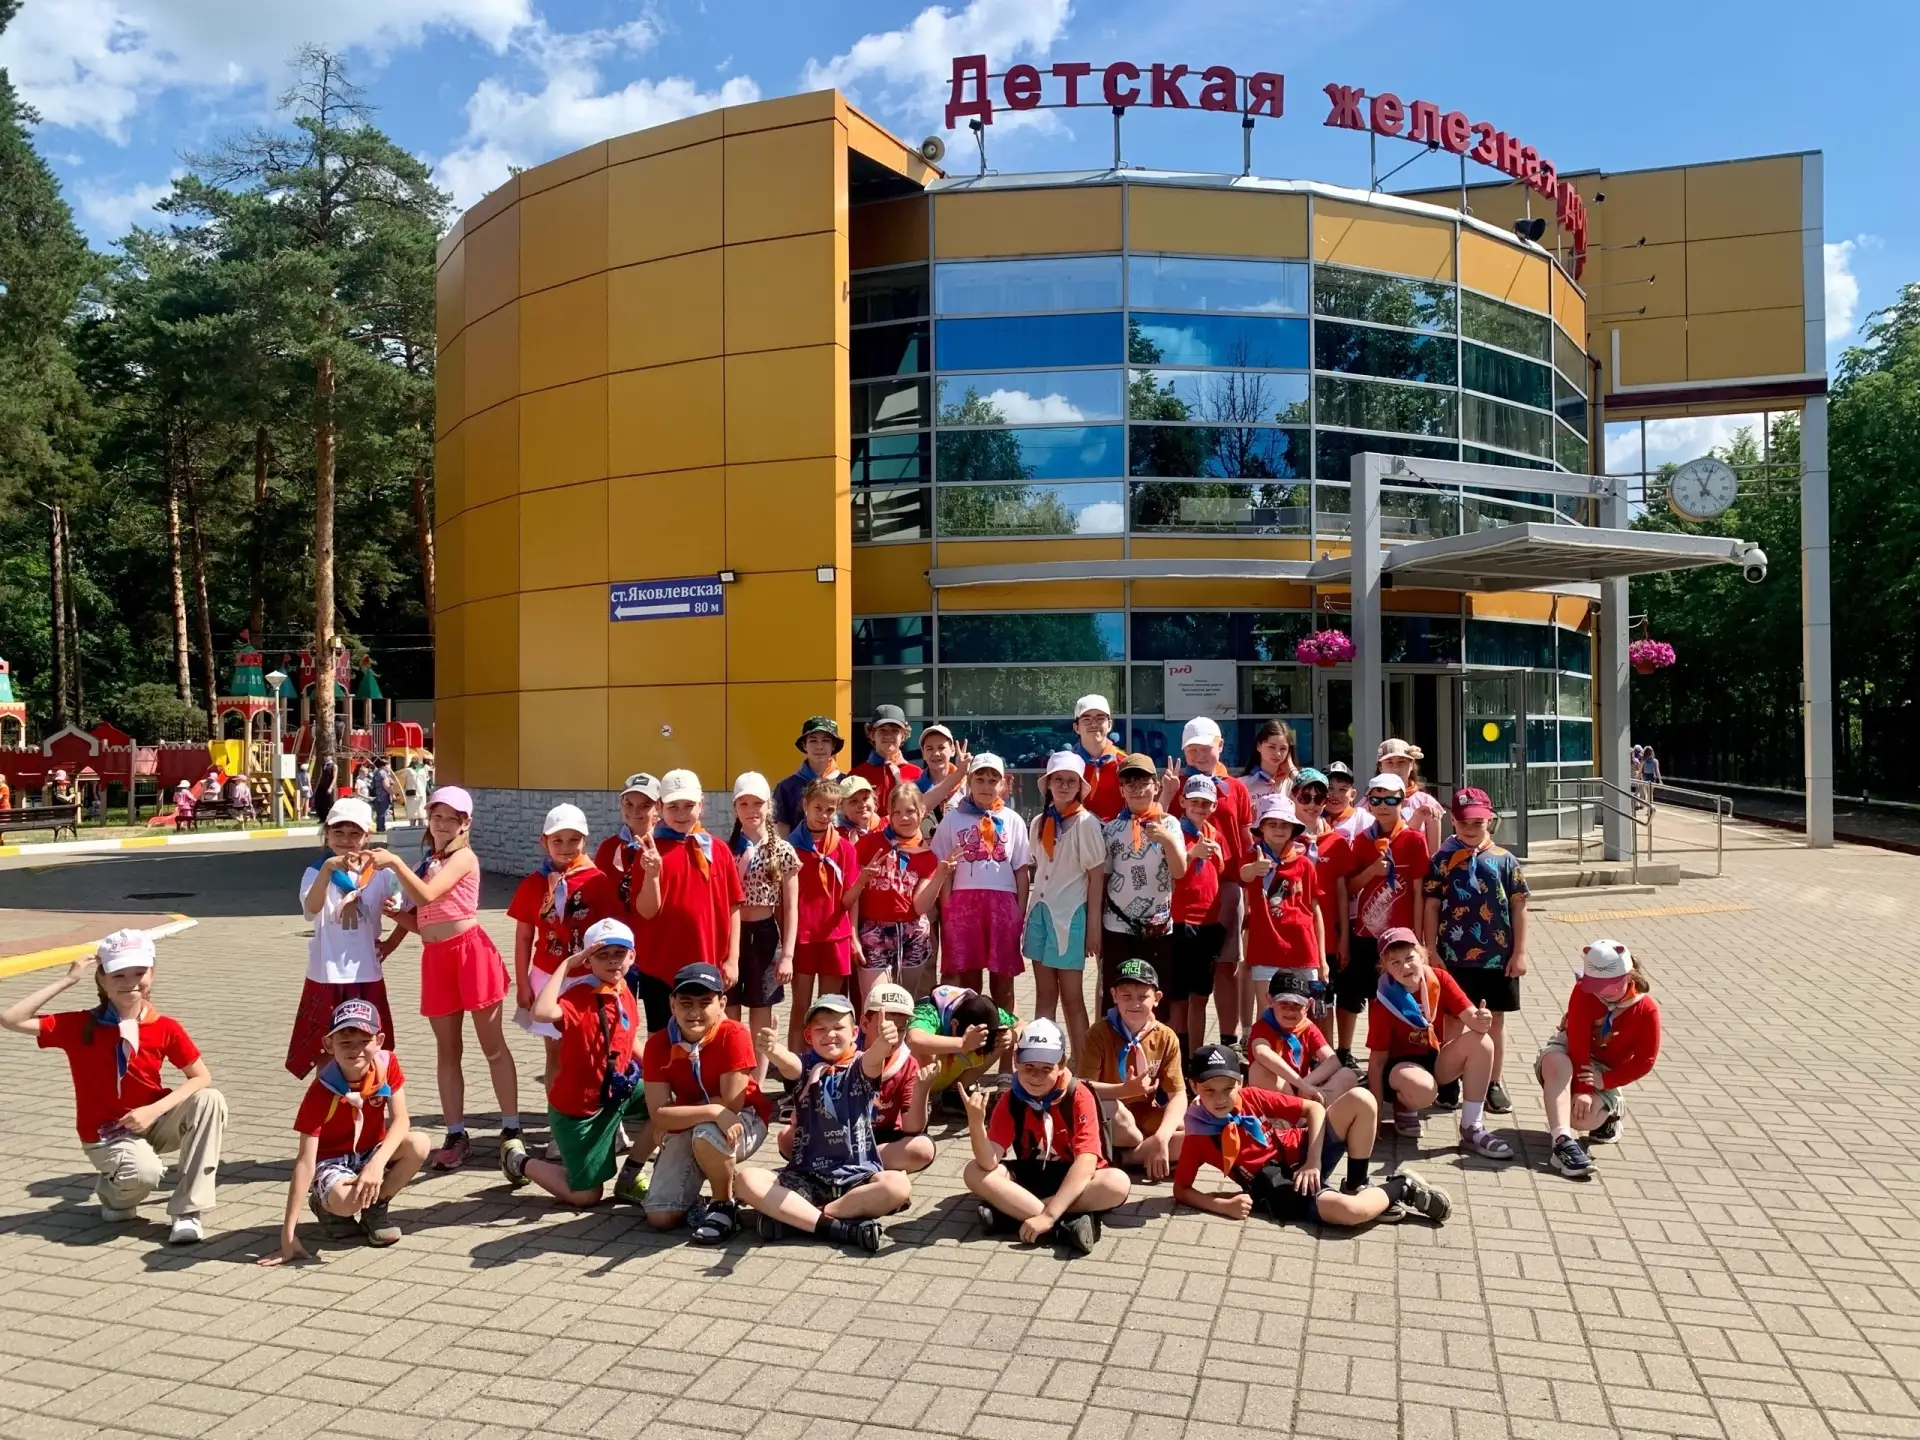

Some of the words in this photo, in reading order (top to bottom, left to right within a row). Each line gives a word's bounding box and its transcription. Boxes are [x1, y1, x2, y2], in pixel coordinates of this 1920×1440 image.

[945, 54, 1285, 130] Детская
[1323, 83, 1558, 199] железная
[611, 584, 722, 602] ст.Яковлевская
[694, 602, 708, 613] 80
[883, 993, 908, 1005] JEANS
